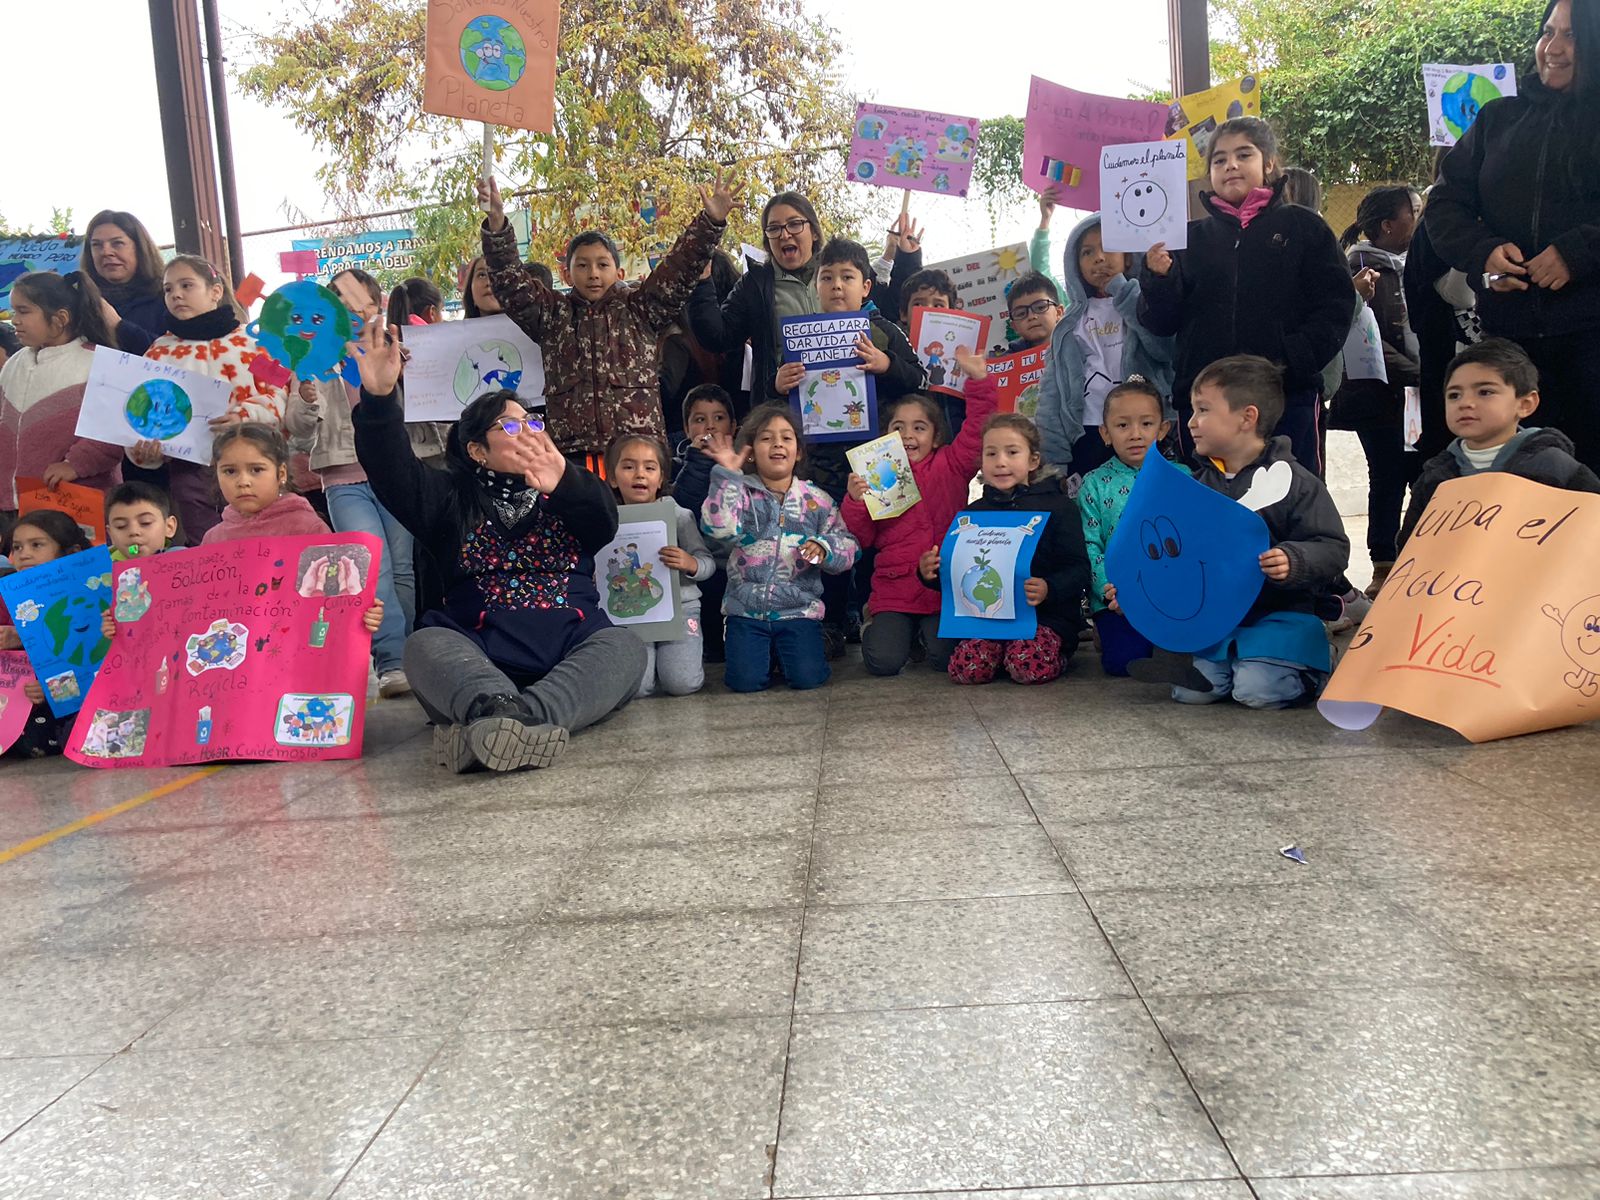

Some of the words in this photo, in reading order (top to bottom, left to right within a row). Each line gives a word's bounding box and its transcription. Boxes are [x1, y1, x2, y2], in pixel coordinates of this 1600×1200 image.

[438, 75, 525, 123] Planeta
[1151, 142, 1186, 168] planeta
[385, 240, 395, 252] A
[386, 255, 408, 269] DEL
[784, 321, 836, 336] RECICLA
[839, 319, 870, 331] PARA
[1087, 321, 1121, 342] Hello
[788, 340, 812, 350] DAR
[815, 335, 848, 347] VIDA
[801, 348, 857, 362] PLANETA
[985, 360, 1014, 374] DEJA
[1022, 354, 1036, 365] TU
[1517, 506, 1579, 546] el
[1408, 613, 1497, 676] Vida
